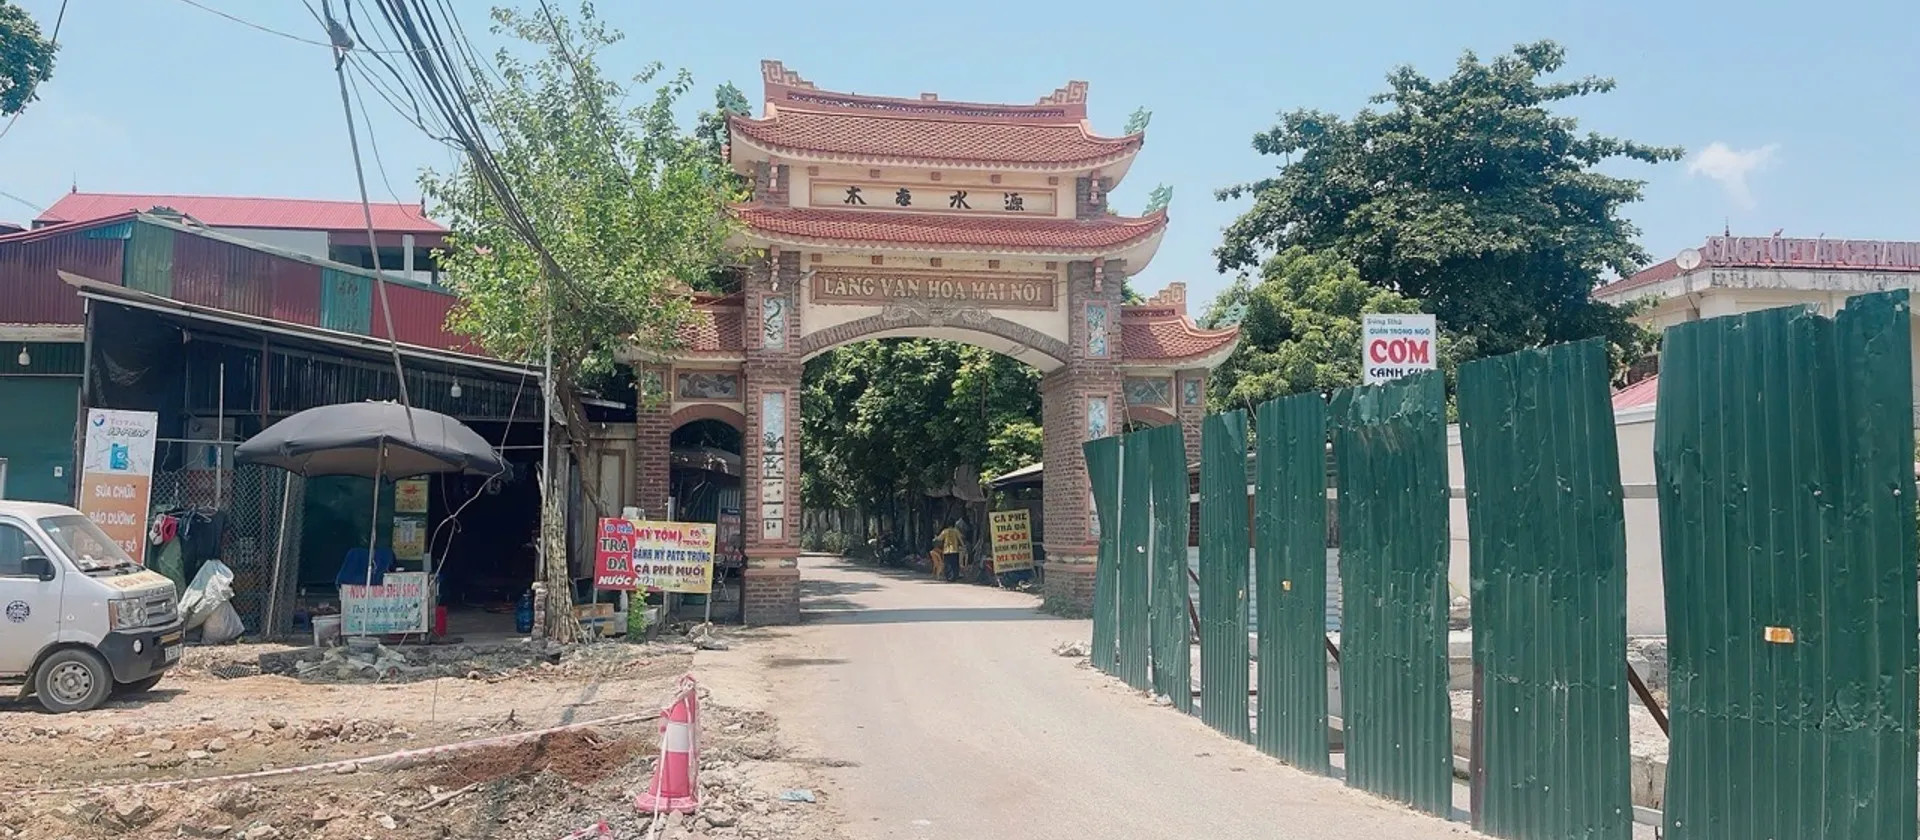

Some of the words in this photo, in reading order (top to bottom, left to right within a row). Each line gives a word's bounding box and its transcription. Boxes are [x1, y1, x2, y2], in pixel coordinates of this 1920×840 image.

[971, 281, 1005, 300] MAI
[1010, 278, 1041, 305] NỘI
[1370, 337, 1430, 364] CƠM
[1370, 368, 1403, 378] CANH
[655, 527, 678, 541] TÔM
[601, 535, 629, 552] TRÀ
[607, 554, 628, 571] ĐÁ
[598, 575, 632, 585] NƯỚC
